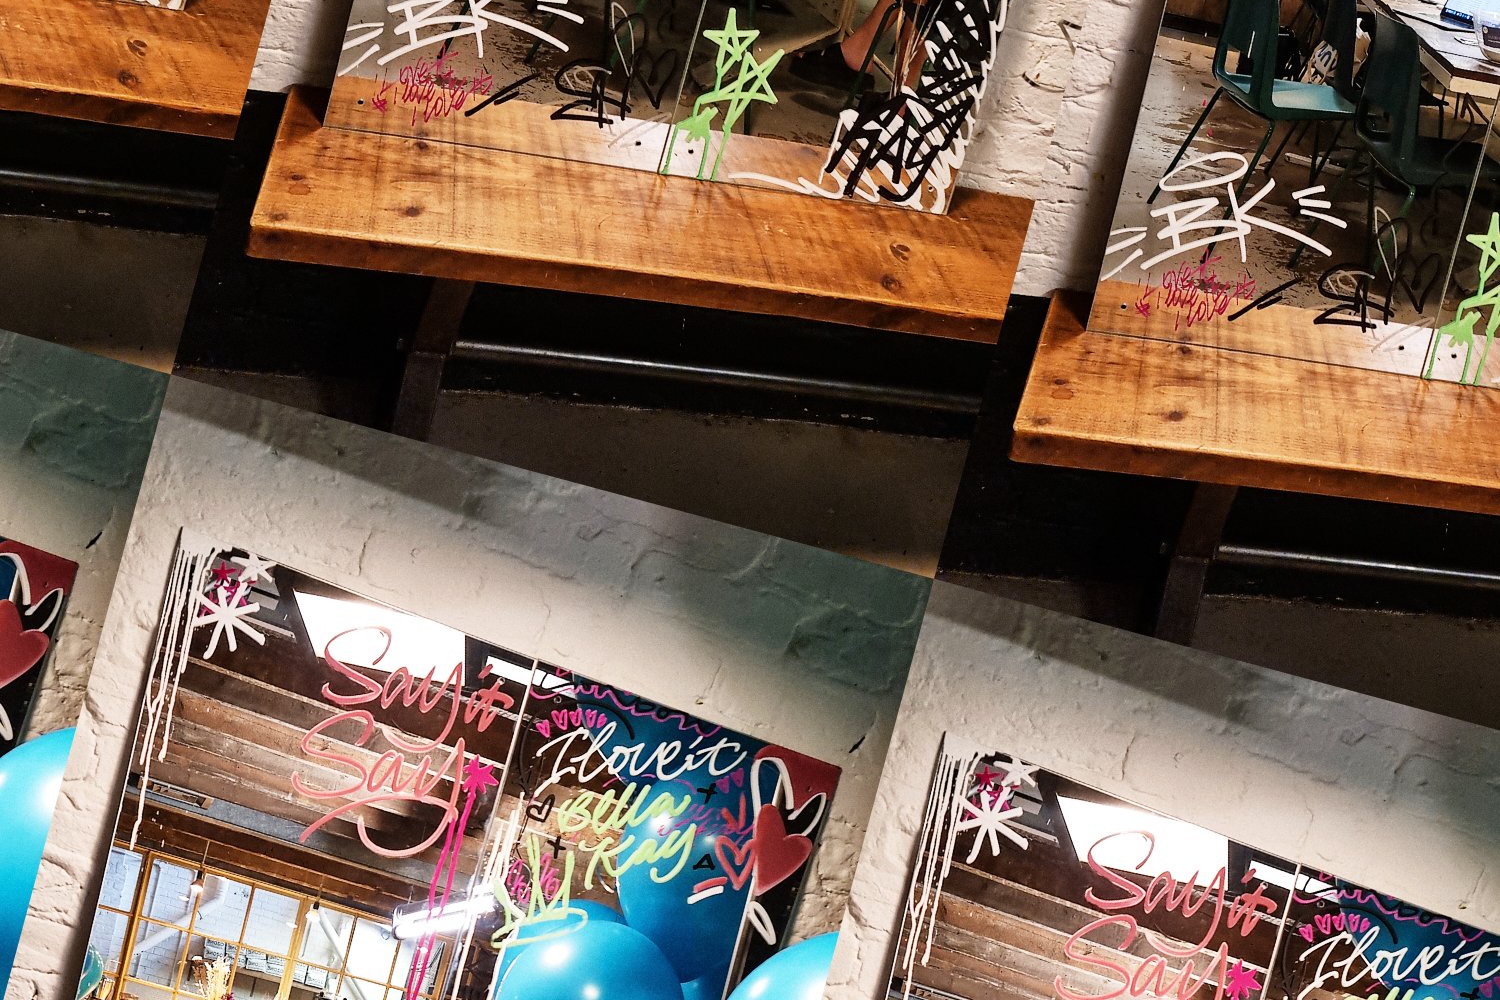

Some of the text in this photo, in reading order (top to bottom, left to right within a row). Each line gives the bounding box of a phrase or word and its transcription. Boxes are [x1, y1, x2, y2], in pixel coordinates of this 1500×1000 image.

[321, 625, 464, 752] Say
[464, 663, 515, 732] it
[291, 709, 465, 857] Say
[556, 781, 692, 834] Bella
[578, 822, 698, 890] Kay
[1084, 830, 1227, 957] Say
[1227, 868, 1278, 937] it
